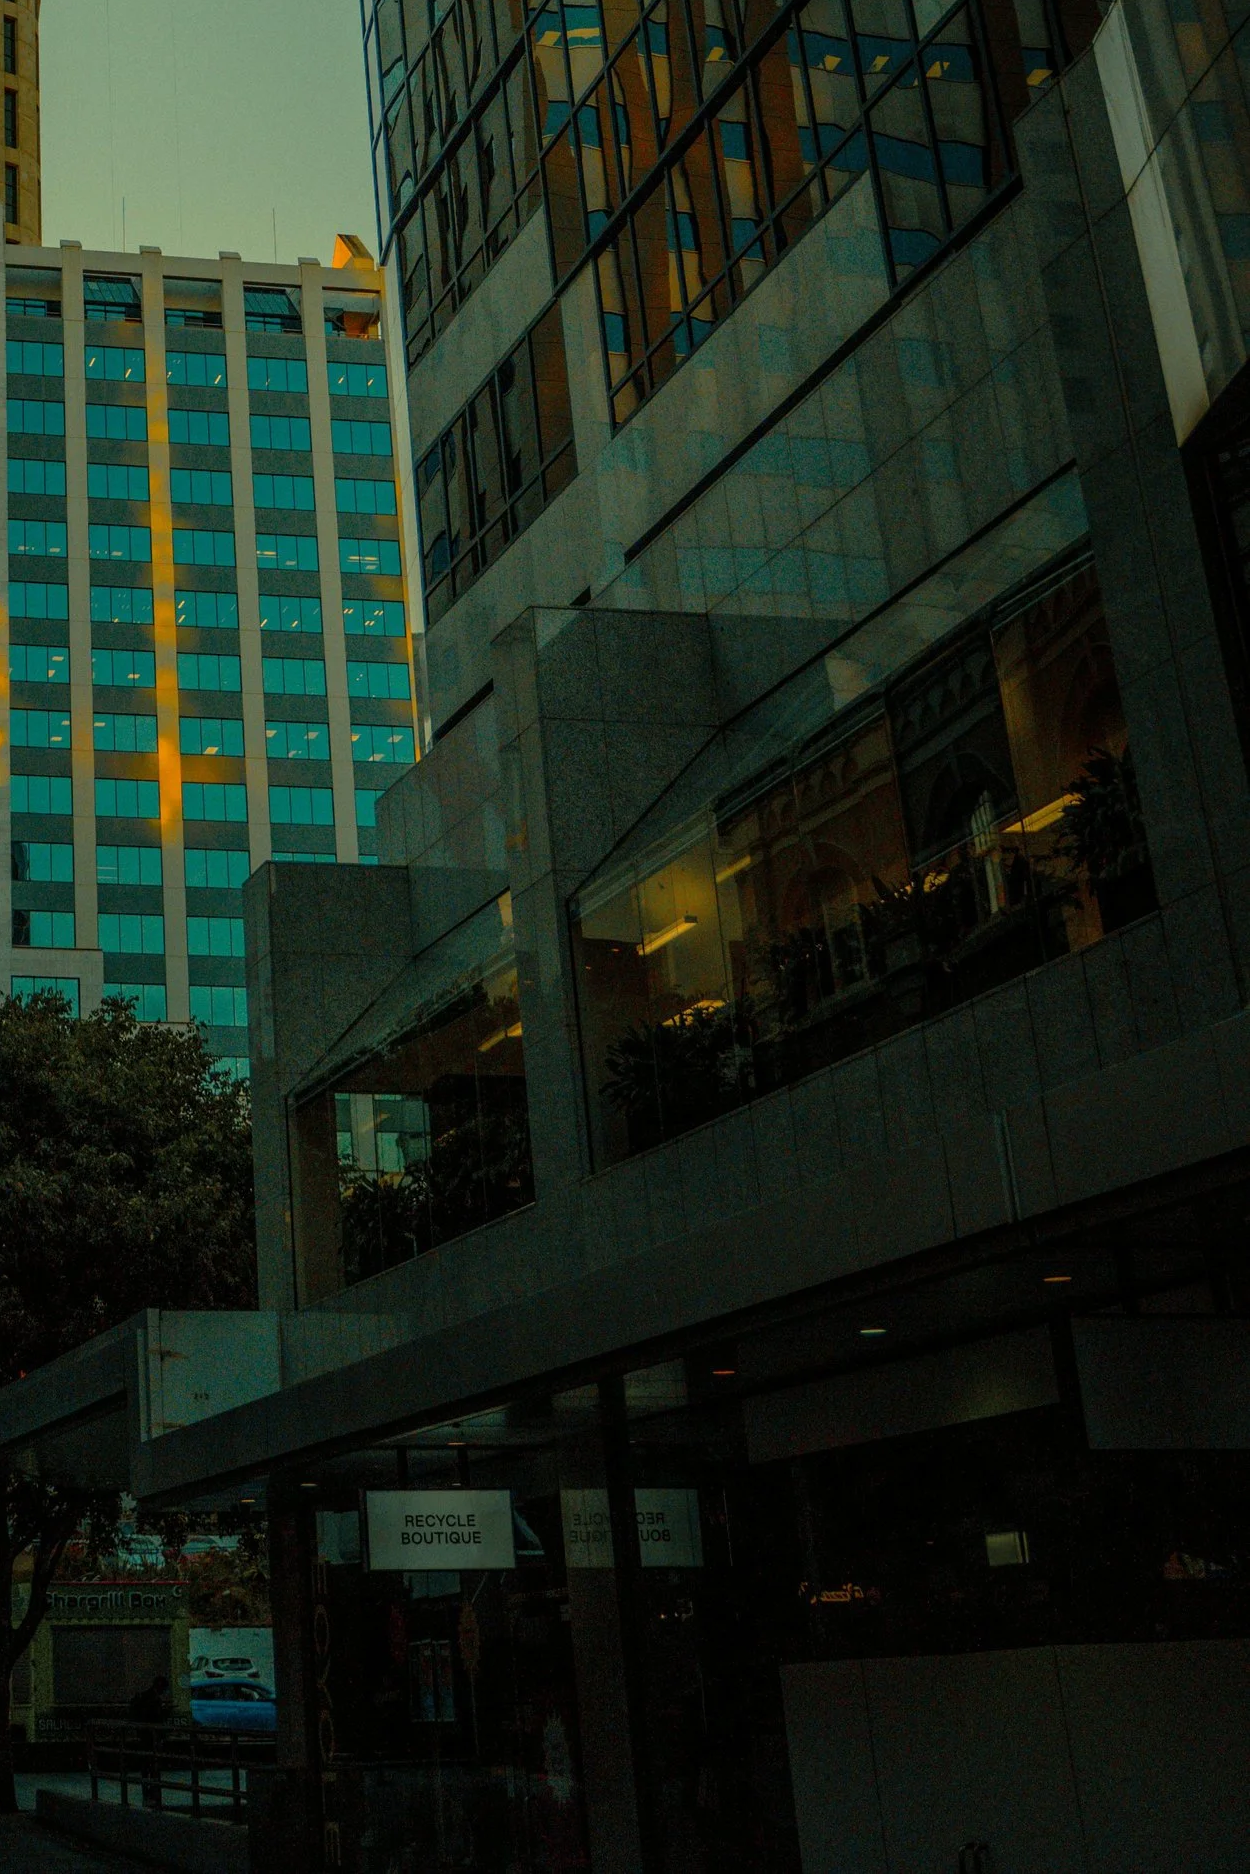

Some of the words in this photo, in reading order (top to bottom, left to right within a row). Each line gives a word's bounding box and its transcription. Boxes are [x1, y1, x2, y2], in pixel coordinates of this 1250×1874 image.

[404, 1514, 476, 1527] RECYCLE
[400, 1531, 482, 1545] BOUTIQUE
[45, 1591, 126, 1612] Chargrill
